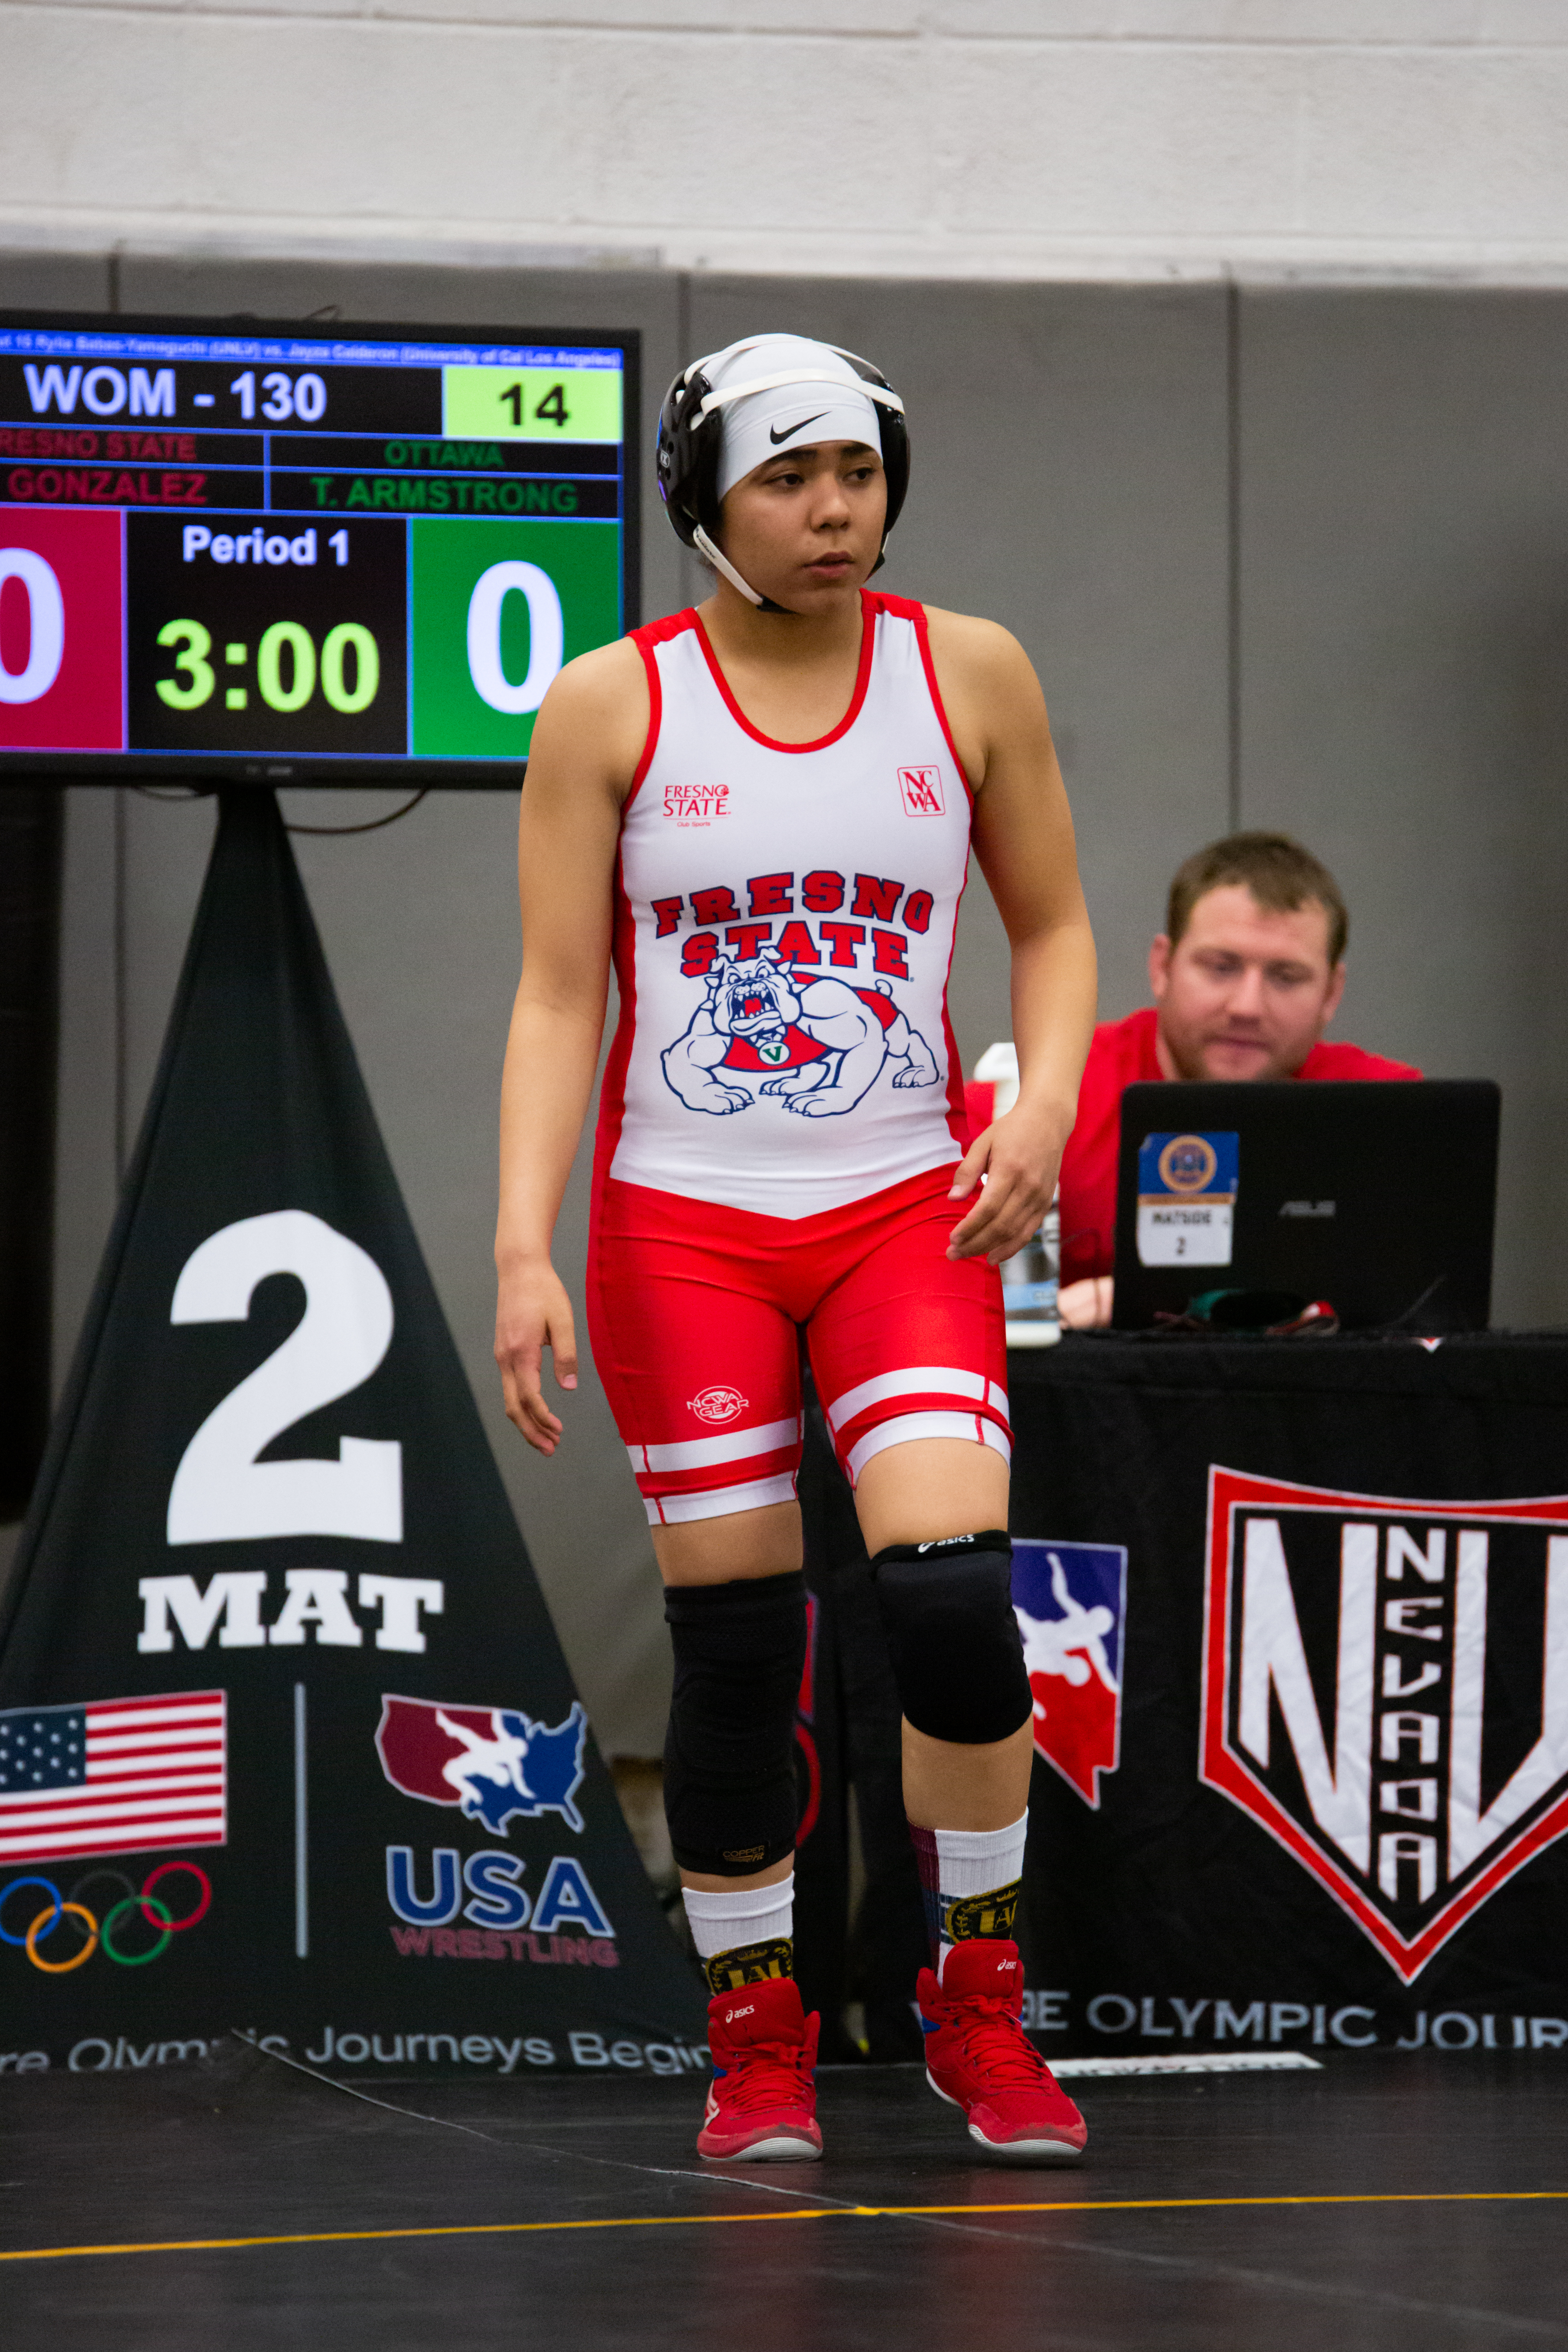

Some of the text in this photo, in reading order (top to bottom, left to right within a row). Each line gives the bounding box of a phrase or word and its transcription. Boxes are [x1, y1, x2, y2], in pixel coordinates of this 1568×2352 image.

[23, 364, 327, 422] WOM - 130
[499, 383, 571, 427] 14
[107, 432, 197, 461] STATE
[384, 440, 505, 467] OTTAWA
[8, 468, 207, 504] GONZALEZ
[310, 477, 578, 513] T. ARMSTRONG
[183, 525, 349, 566] Period 1
[0, 547, 65, 705] 0
[467, 560, 564, 715] 0
[155, 618, 380, 714] 3:00
[663, 798, 728, 817] STATE
[665, 784, 729, 798] FRESNO
[650, 870, 934, 939] FRESNO
[680, 920, 909, 981] STATE
[762, 1046, 782, 1062] V
[166, 1209, 403, 1546] 2
[686, 1393, 740, 1410] NCWA
[699, 1399, 750, 1417] GEAR
[937, 1534, 974, 1546] asics
[137, 1568, 444, 1653] MAT
[1378, 1525, 1446, 1904] NEVADA
[722, 1845, 765, 1857] COPPER
[386, 1845, 616, 1938] USA
[389, 1925, 620, 1968] WRESTLING
[734, 2005, 755, 2018] asics
[1086, 1993, 1379, 2047] OLYMPIC
[305, 2025, 557, 2074] Journeys
